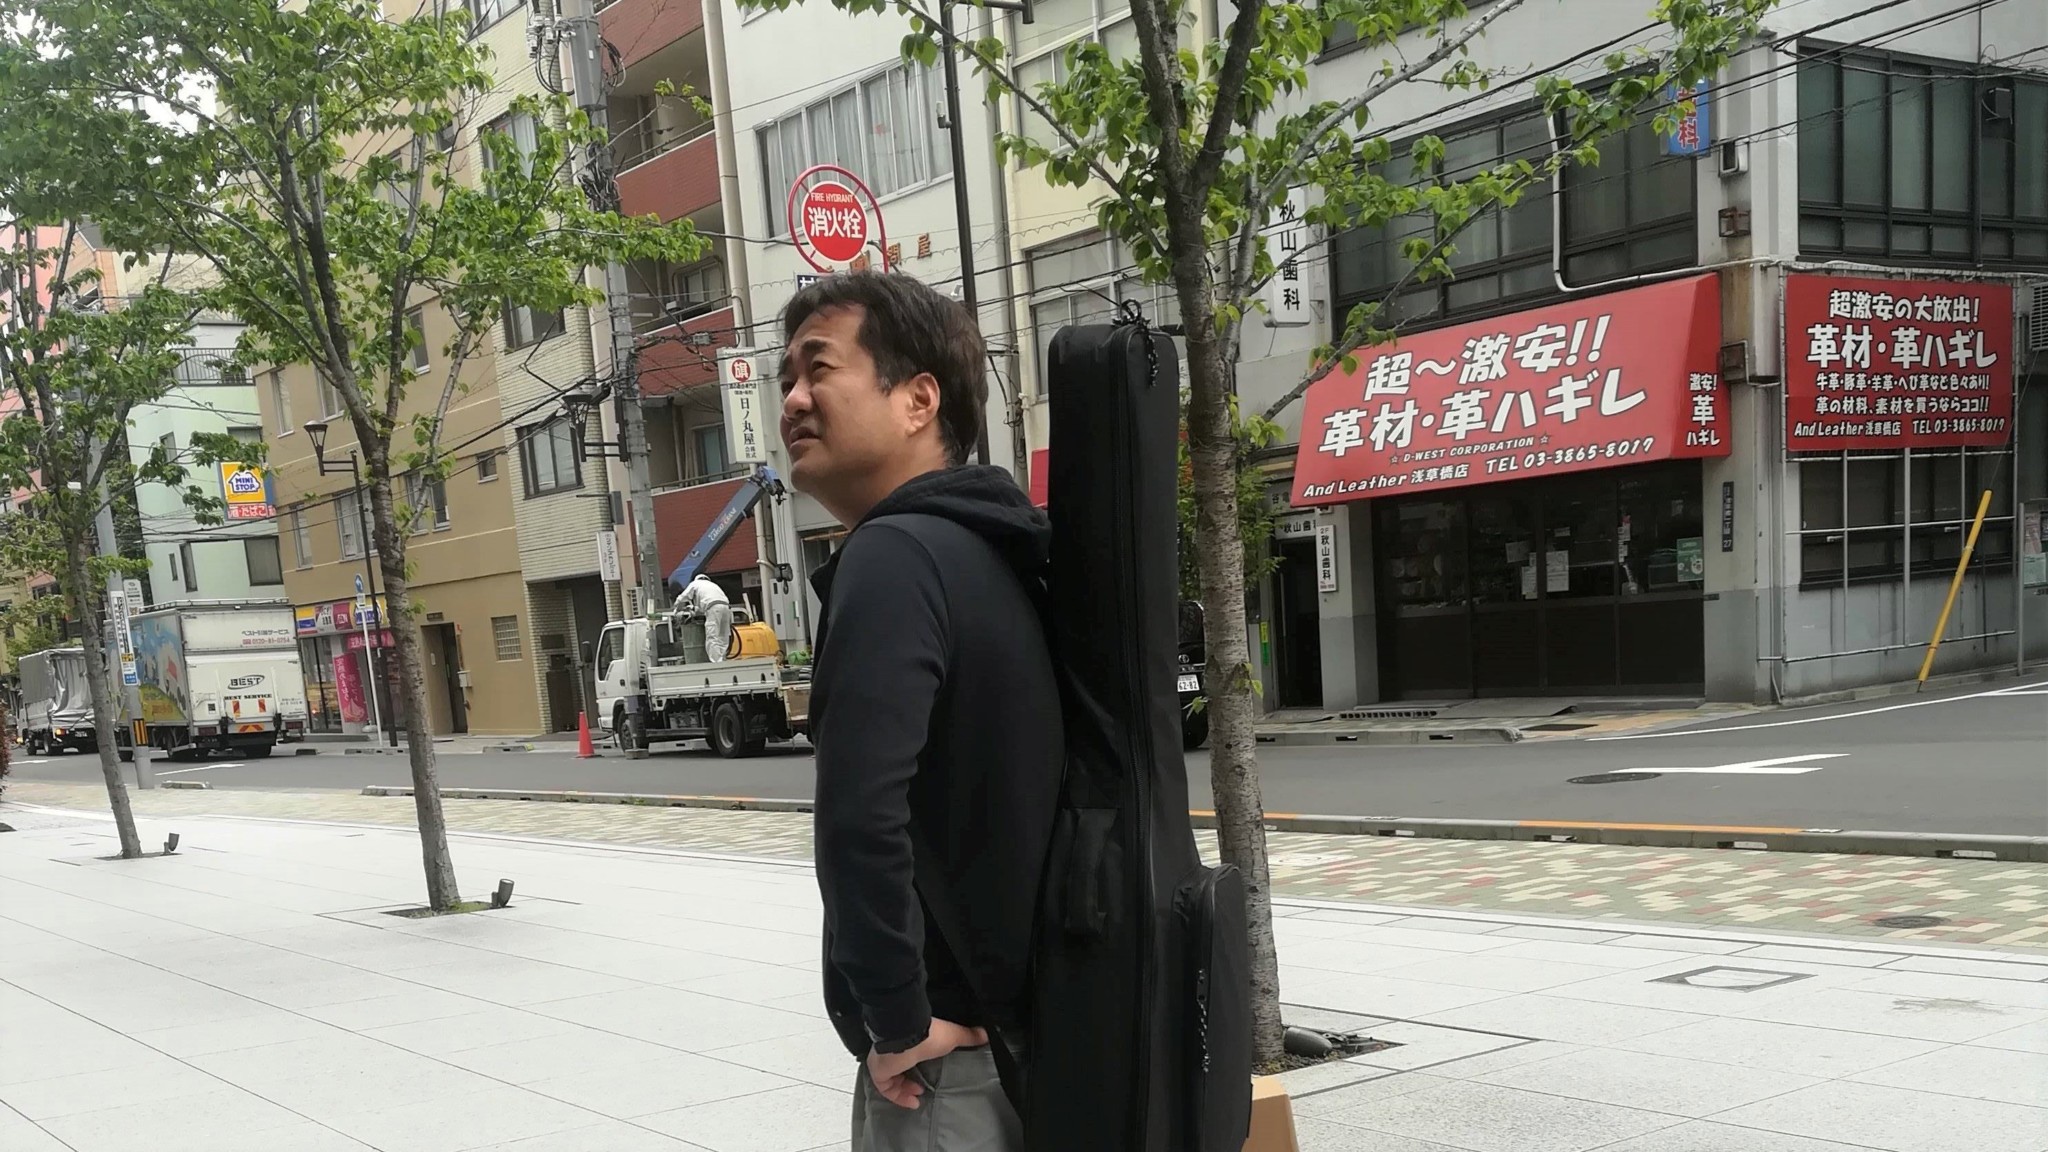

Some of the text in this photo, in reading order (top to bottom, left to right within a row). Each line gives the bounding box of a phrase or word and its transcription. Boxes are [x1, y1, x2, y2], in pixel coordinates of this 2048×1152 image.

[811, 193, 854, 203] FIRE HYDRANT
[807, 206, 863, 238] 消火栓
[1280, 200, 1300, 310] 秋山歯科
[1829, 289, 1980, 324] 超激安の大放出!
[1807, 323, 1998, 369] 革材・革ハギレ
[1689, 373, 1718, 392] 激安!
[740, 398, 755, 445] 日ノ丸屋
[1319, 368, 1648, 457] 革材・革ハギレ
[1692, 395, 1716, 426] 革
[1686, 429, 1721, 447] ハギレ
[1794, 418, 2005, 437] And Leather 浅草橋店 TEL 03-3865-8017
[1403, 436, 1534, 463] D-WEST CORPORATION
[1303, 437, 1655, 498] And Leather 浅草橋店 TEL 03-3865-8017
[230, 677, 260, 687] BEST
